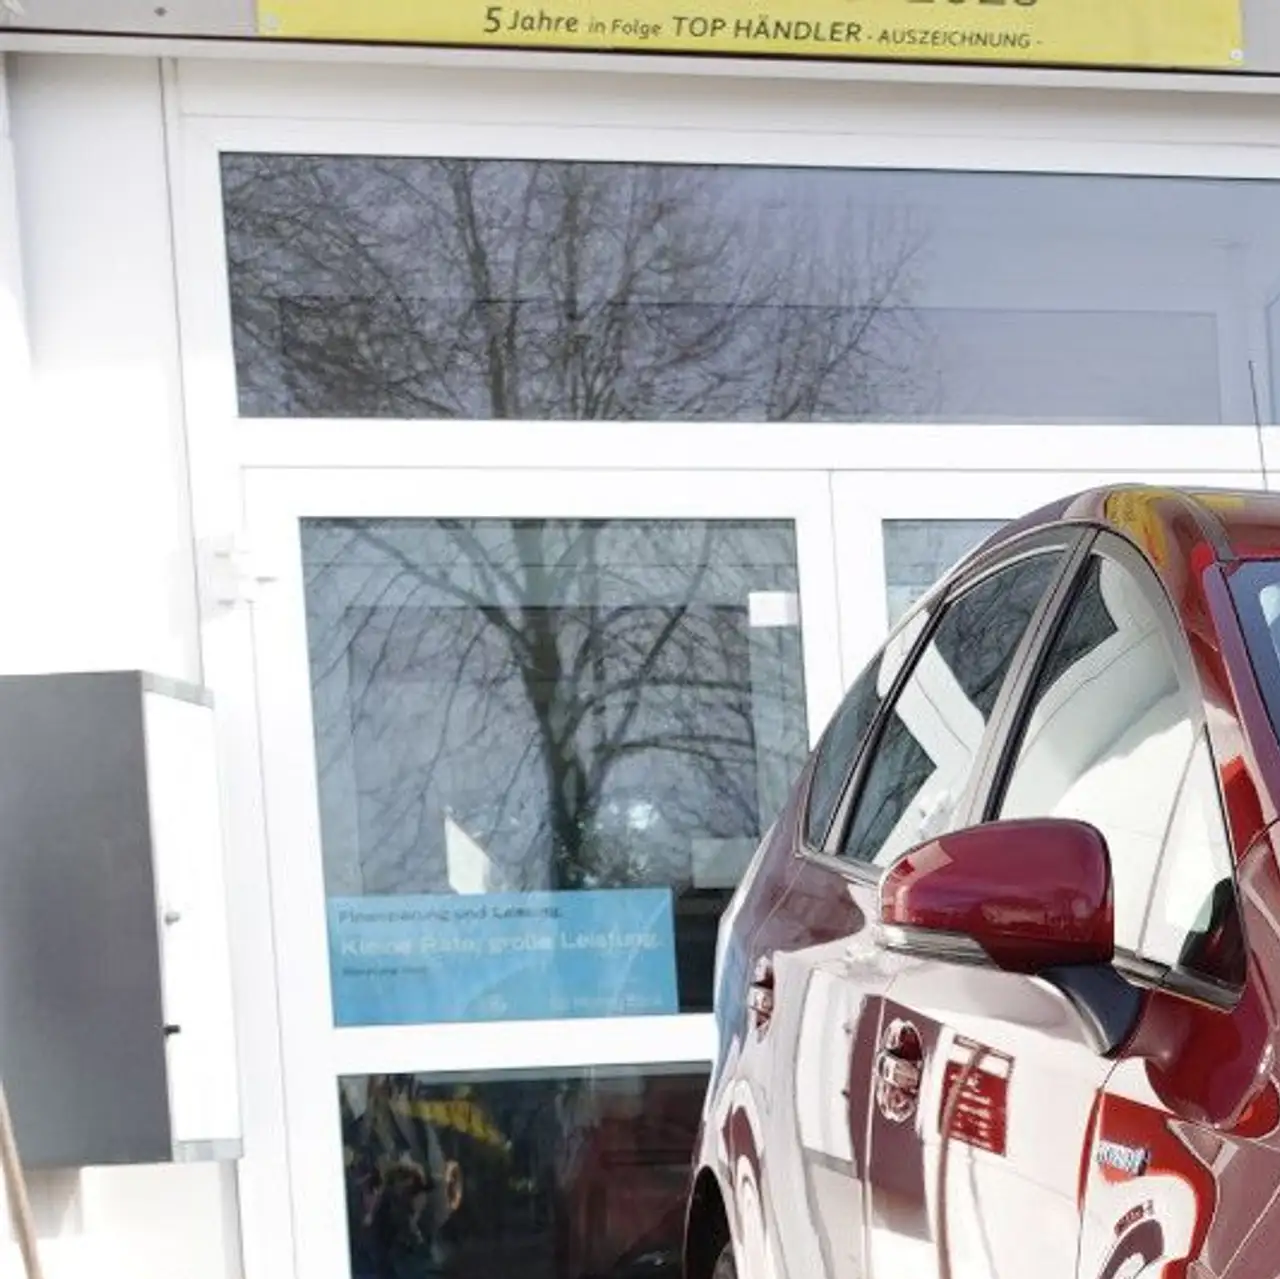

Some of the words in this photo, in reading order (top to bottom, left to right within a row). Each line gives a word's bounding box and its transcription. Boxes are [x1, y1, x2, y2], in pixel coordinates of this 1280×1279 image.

[483, 6, 501, 33] 5
[508, 10, 578, 32] Jahre
[589, 18, 606, 33] in
[611, 19, 661, 39] Folge
[673, 16, 726, 37] TOP
[734, 15, 862, 42] HÄNDLER
[878, 29, 1030, 48] AUSZEICHNUNG
